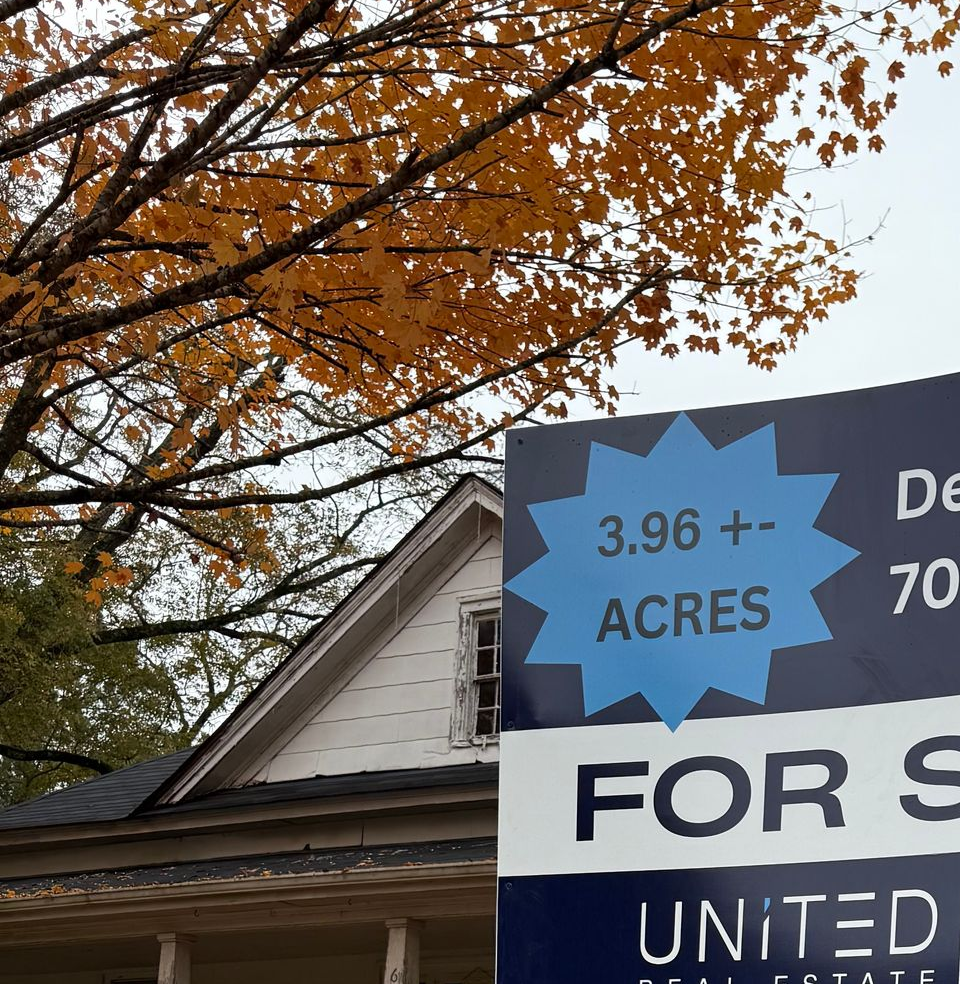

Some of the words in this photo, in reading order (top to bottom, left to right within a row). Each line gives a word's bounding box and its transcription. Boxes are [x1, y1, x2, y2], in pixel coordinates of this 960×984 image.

[597, 508, 700, 557] 3.96
[720, 509, 776, 546] +-
[596, 586, 771, 643] ACRES
[575, 749, 849, 842] FOR
